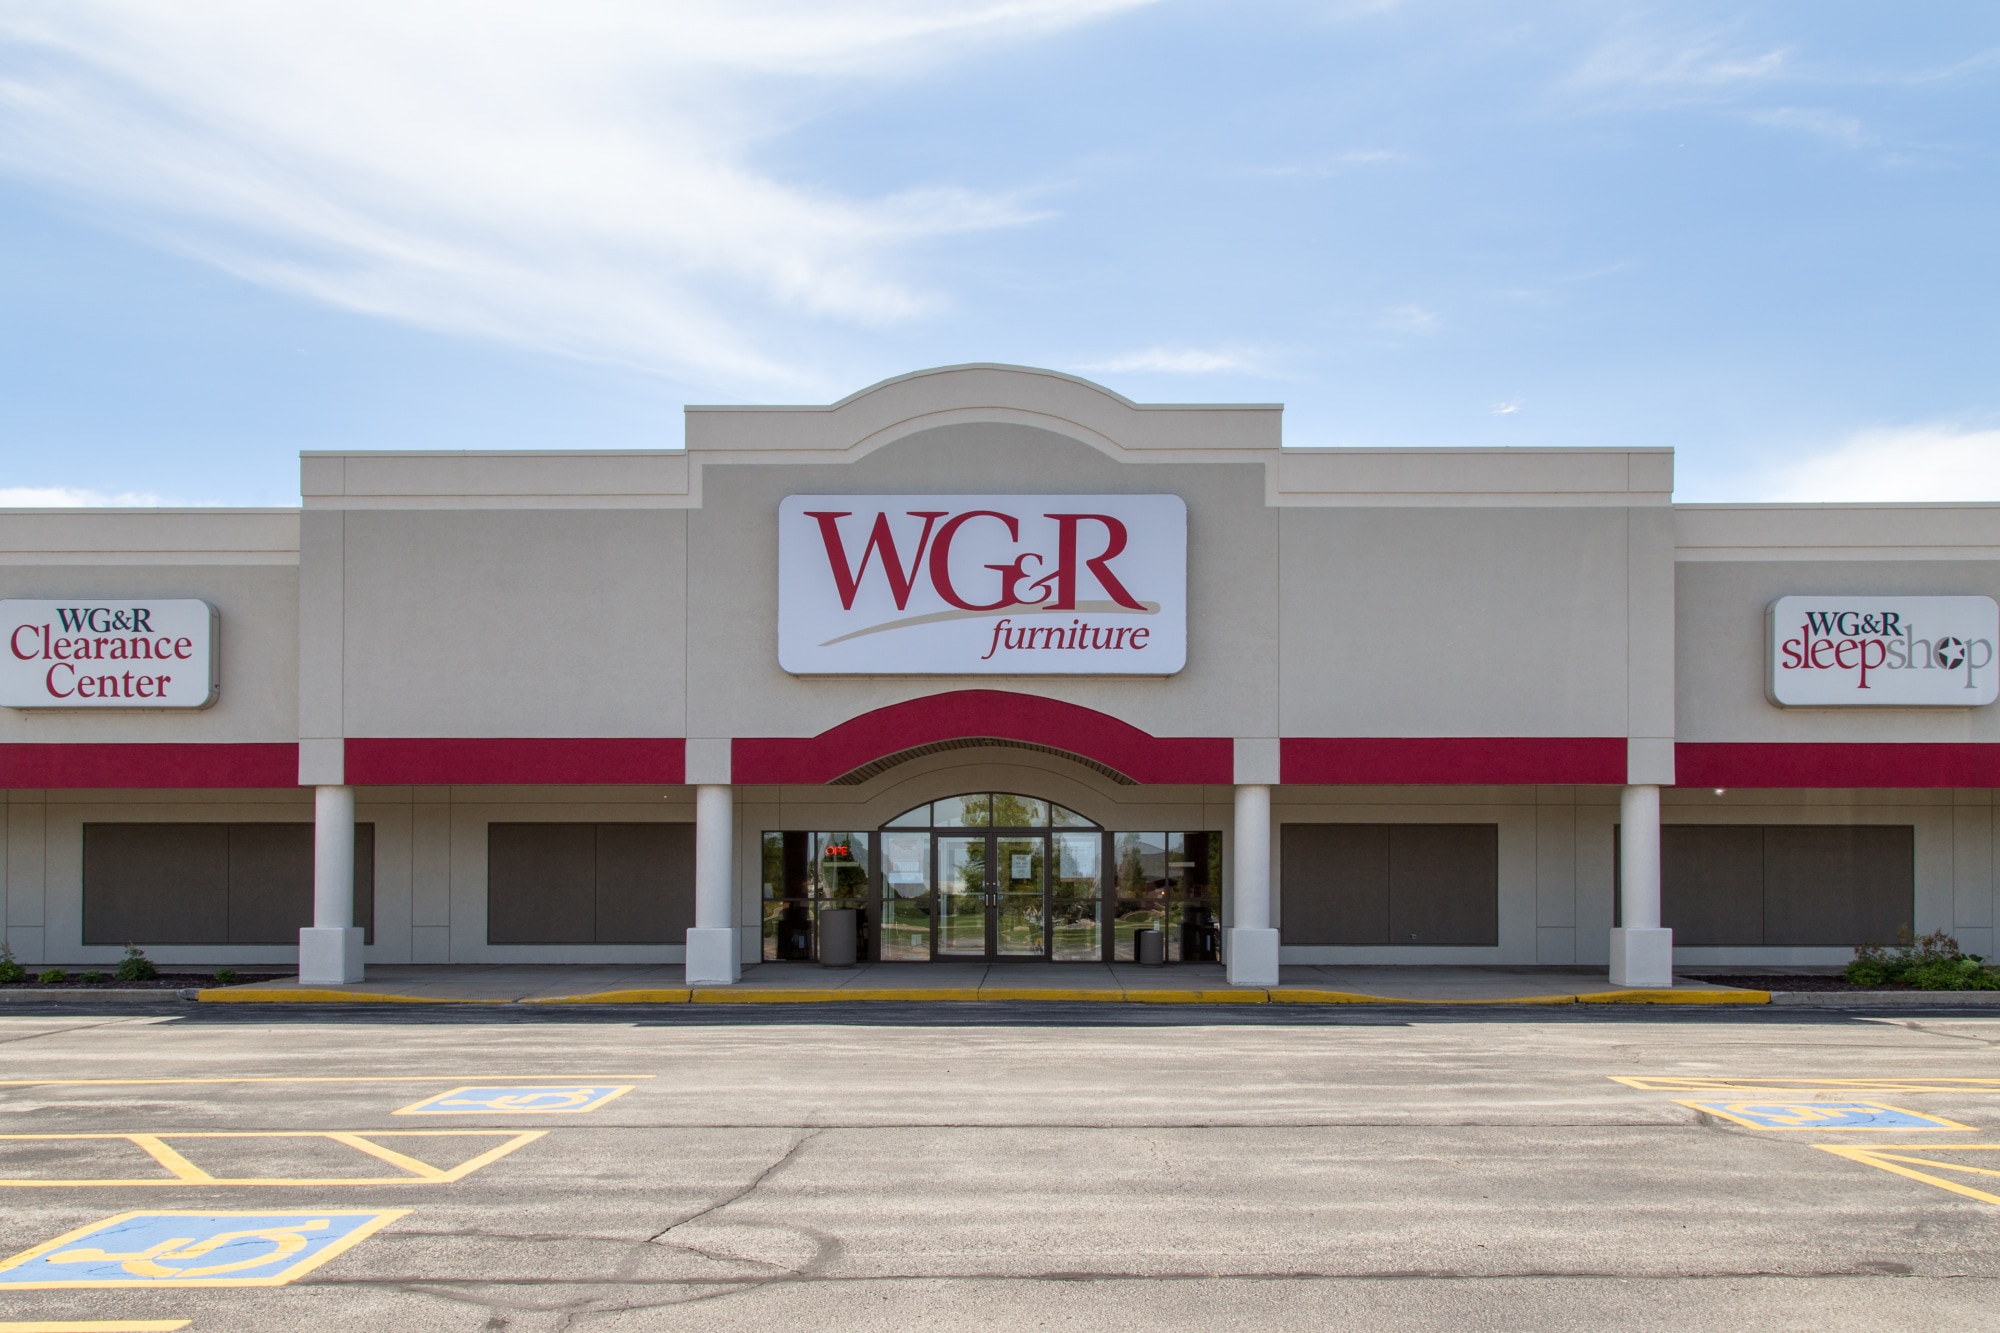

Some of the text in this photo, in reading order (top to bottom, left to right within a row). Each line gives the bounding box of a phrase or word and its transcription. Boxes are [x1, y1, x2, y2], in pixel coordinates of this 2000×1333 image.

[803, 510, 1148, 612] WG&R
[56, 608, 155, 633] WG&R
[1805, 611, 1903, 636] WG&R
[10, 624, 193, 660] Clearance
[980, 619, 1150, 660] furniture
[46, 663, 171, 698] Center
